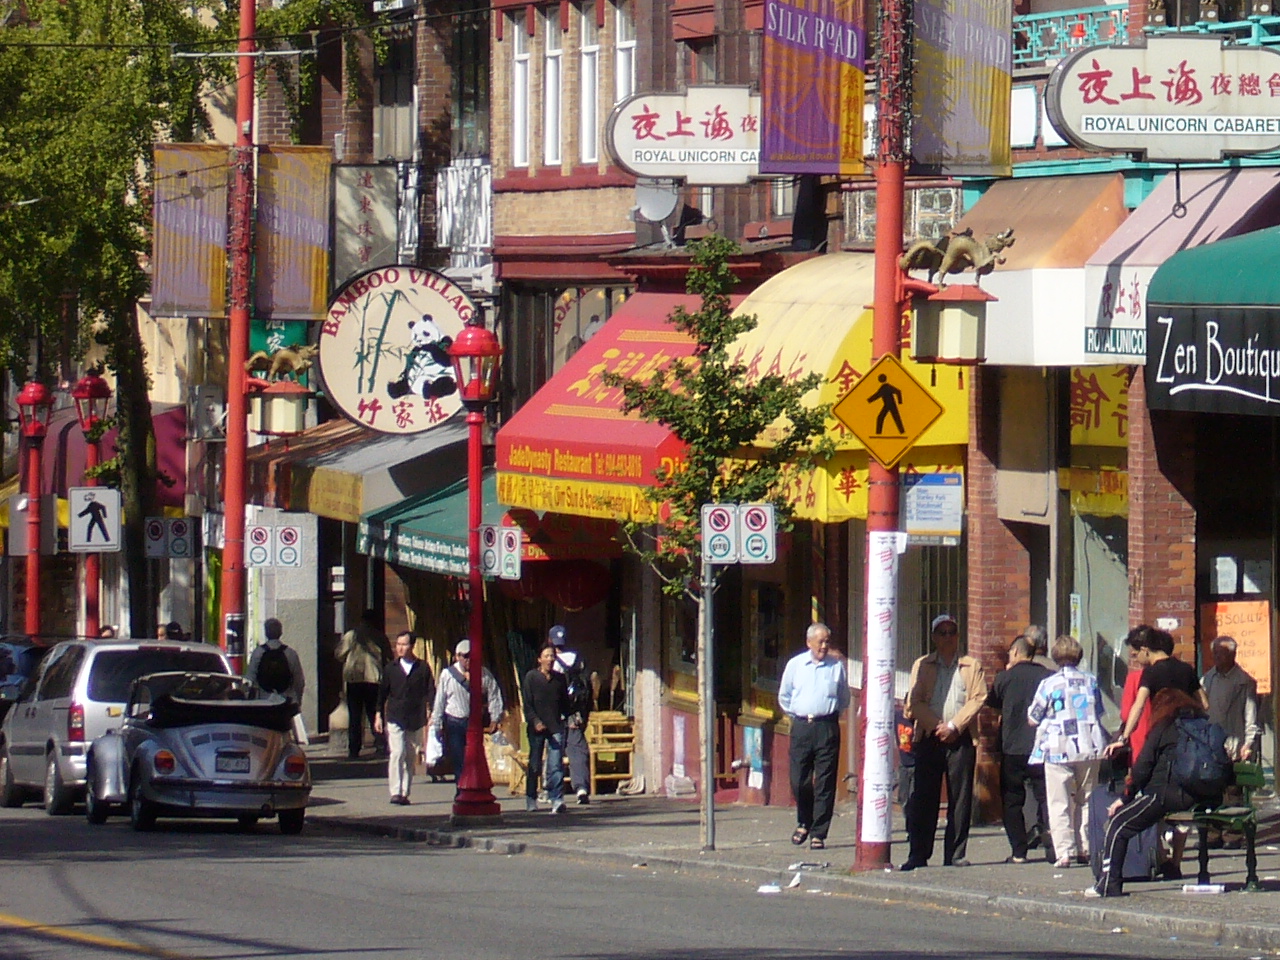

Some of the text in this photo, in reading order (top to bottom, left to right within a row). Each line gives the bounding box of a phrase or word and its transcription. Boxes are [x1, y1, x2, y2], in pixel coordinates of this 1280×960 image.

[768, 1, 858, 60] SILK ROAD
[965, 22, 1007, 65] ROAD
[1084, 117, 1134, 131] ROYAL
[1138, 117, 1207, 132] UNICORN
[634, 150, 676, 162] ROYAL
[678, 151, 735, 162] UNICORN
[322, 268, 475, 338] BAMBOO VILLAG
[1088, 329, 1146, 354] ROYAL UNICO
[1156, 316, 1196, 383] Zen
[357, 397, 449, 429] 竹家莊
